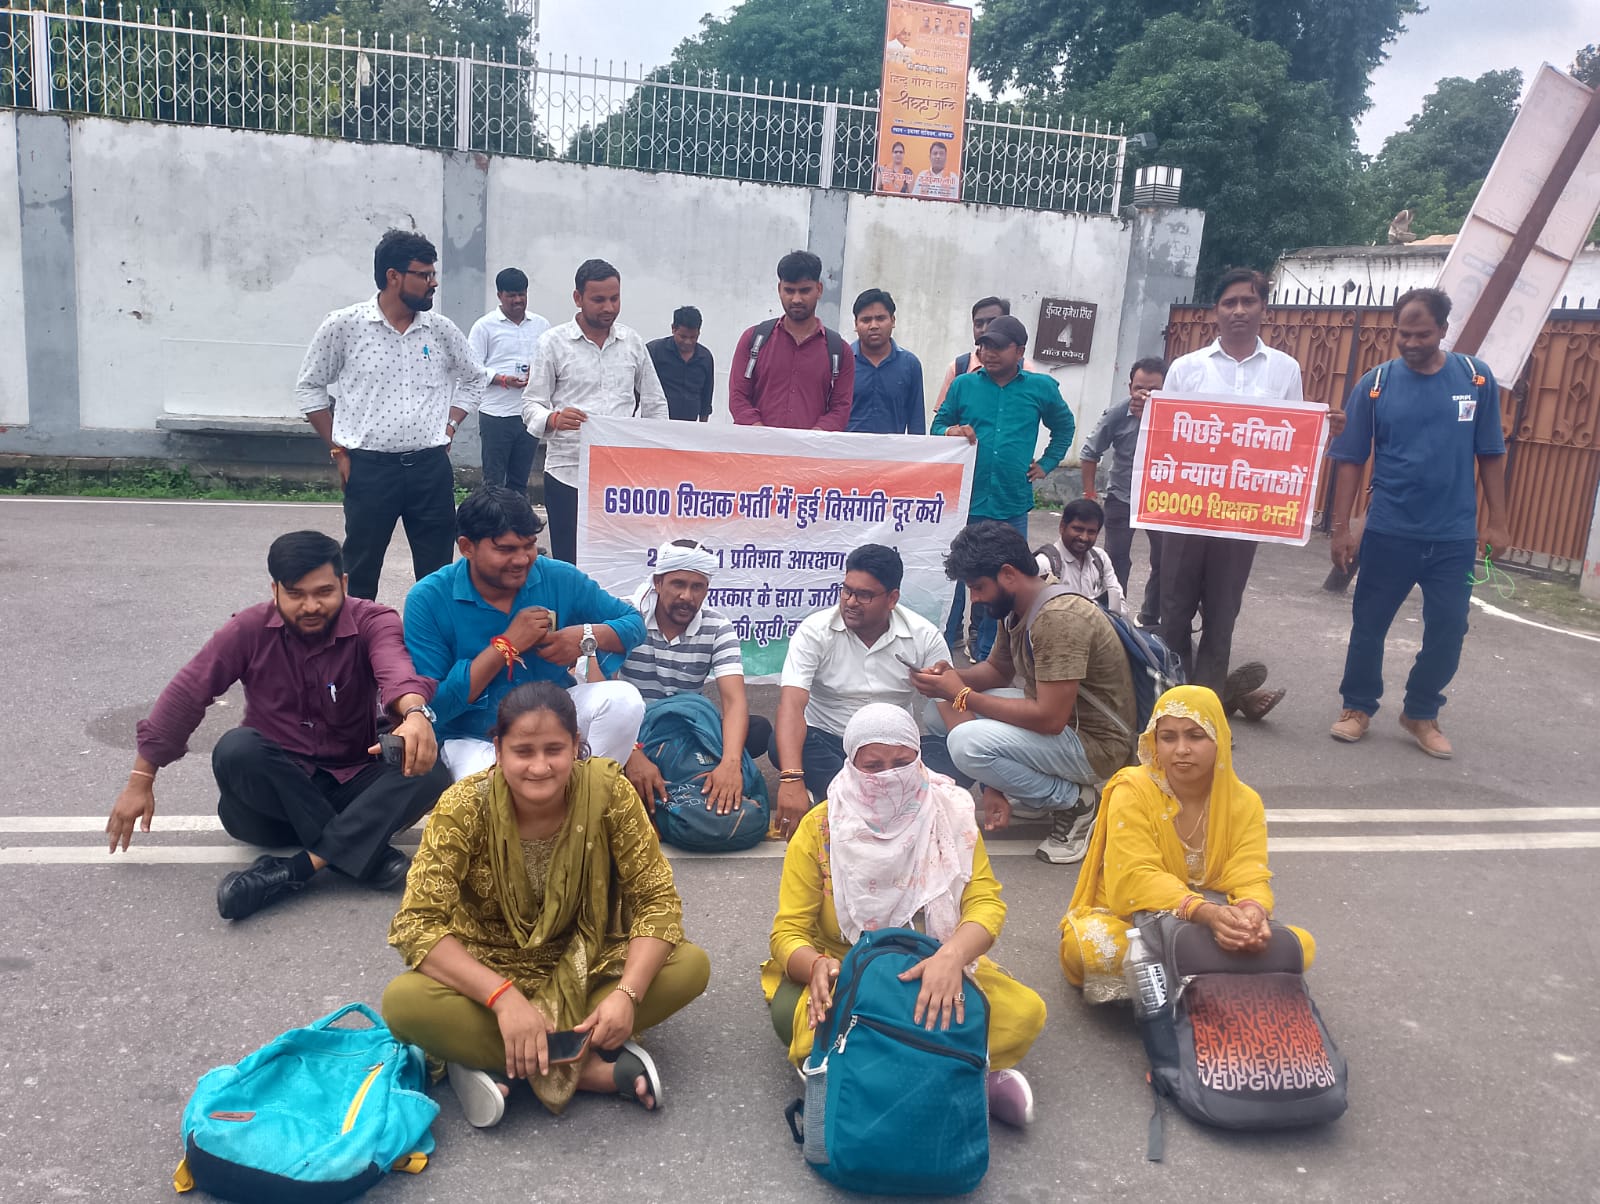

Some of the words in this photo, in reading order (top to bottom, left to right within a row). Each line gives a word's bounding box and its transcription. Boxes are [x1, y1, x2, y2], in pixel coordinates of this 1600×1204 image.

[1057, 322, 1072, 348] 4
[1150, 453, 1178, 484] को
[1180, 461, 1229, 489] न्याय
[1229, 459, 1308, 496] दिलाओं
[605, 487, 670, 515] 69000
[676, 483, 735, 517] शिक्षक
[739, 486, 773, 519] भर्ती
[777, 486, 793, 519] में
[796, 488, 820, 529] हुई
[825, 489, 888, 523] विसंगति
[892, 499, 913, 532] दूर
[915, 493, 945, 524] करो
[1147, 490, 1203, 518] 69000
[1206, 492, 1261, 523] शिक्षक
[1261, 500, 1301, 528] भर्ती
[731, 543, 784, 569] प्रतिशत
[787, 549, 847, 571] आरक्षण
[707, 587, 756, 608] सरकार
[757, 582, 773, 608] के
[775, 587, 805, 609] द्वारा
[808, 582, 842, 608] जारी
[755, 614, 785, 646] सूची
